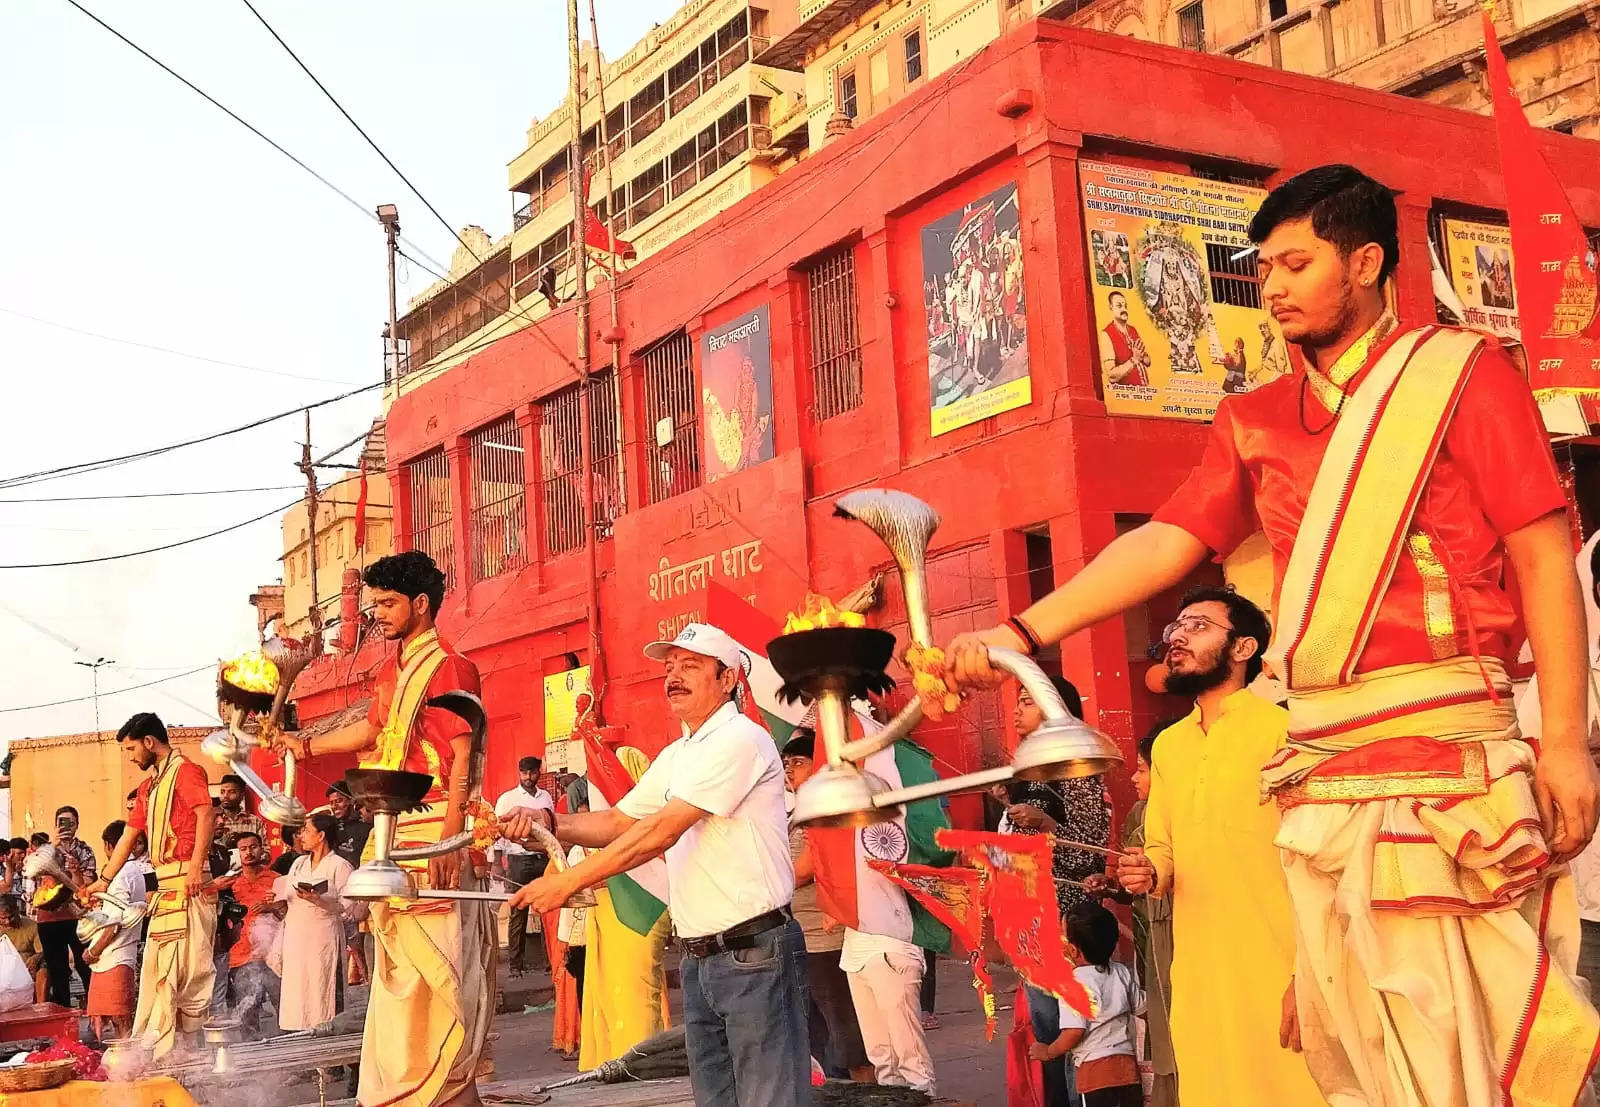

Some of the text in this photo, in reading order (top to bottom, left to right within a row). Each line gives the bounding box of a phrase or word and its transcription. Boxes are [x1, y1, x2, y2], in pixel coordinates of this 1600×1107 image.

[1086, 182, 1096, 196] श्री
[1169, 194, 1179, 209] श्री
[1086, 199, 1103, 211] SHRI
[1198, 216, 1212, 228] SHRI
[1213, 219, 1227, 230] BARI
[1228, 222, 1250, 233] SHITL
[1540, 213, 1562, 225] राम
[1540, 261, 1562, 273] राम
[709, 335, 727, 353] विराट
[1539, 358, 1563, 371] राम
[1162, 404, 1181, 414] अपनी
[1184, 405, 1203, 416] सुरक्षा
[649, 539, 764, 602] शीतला घाट
